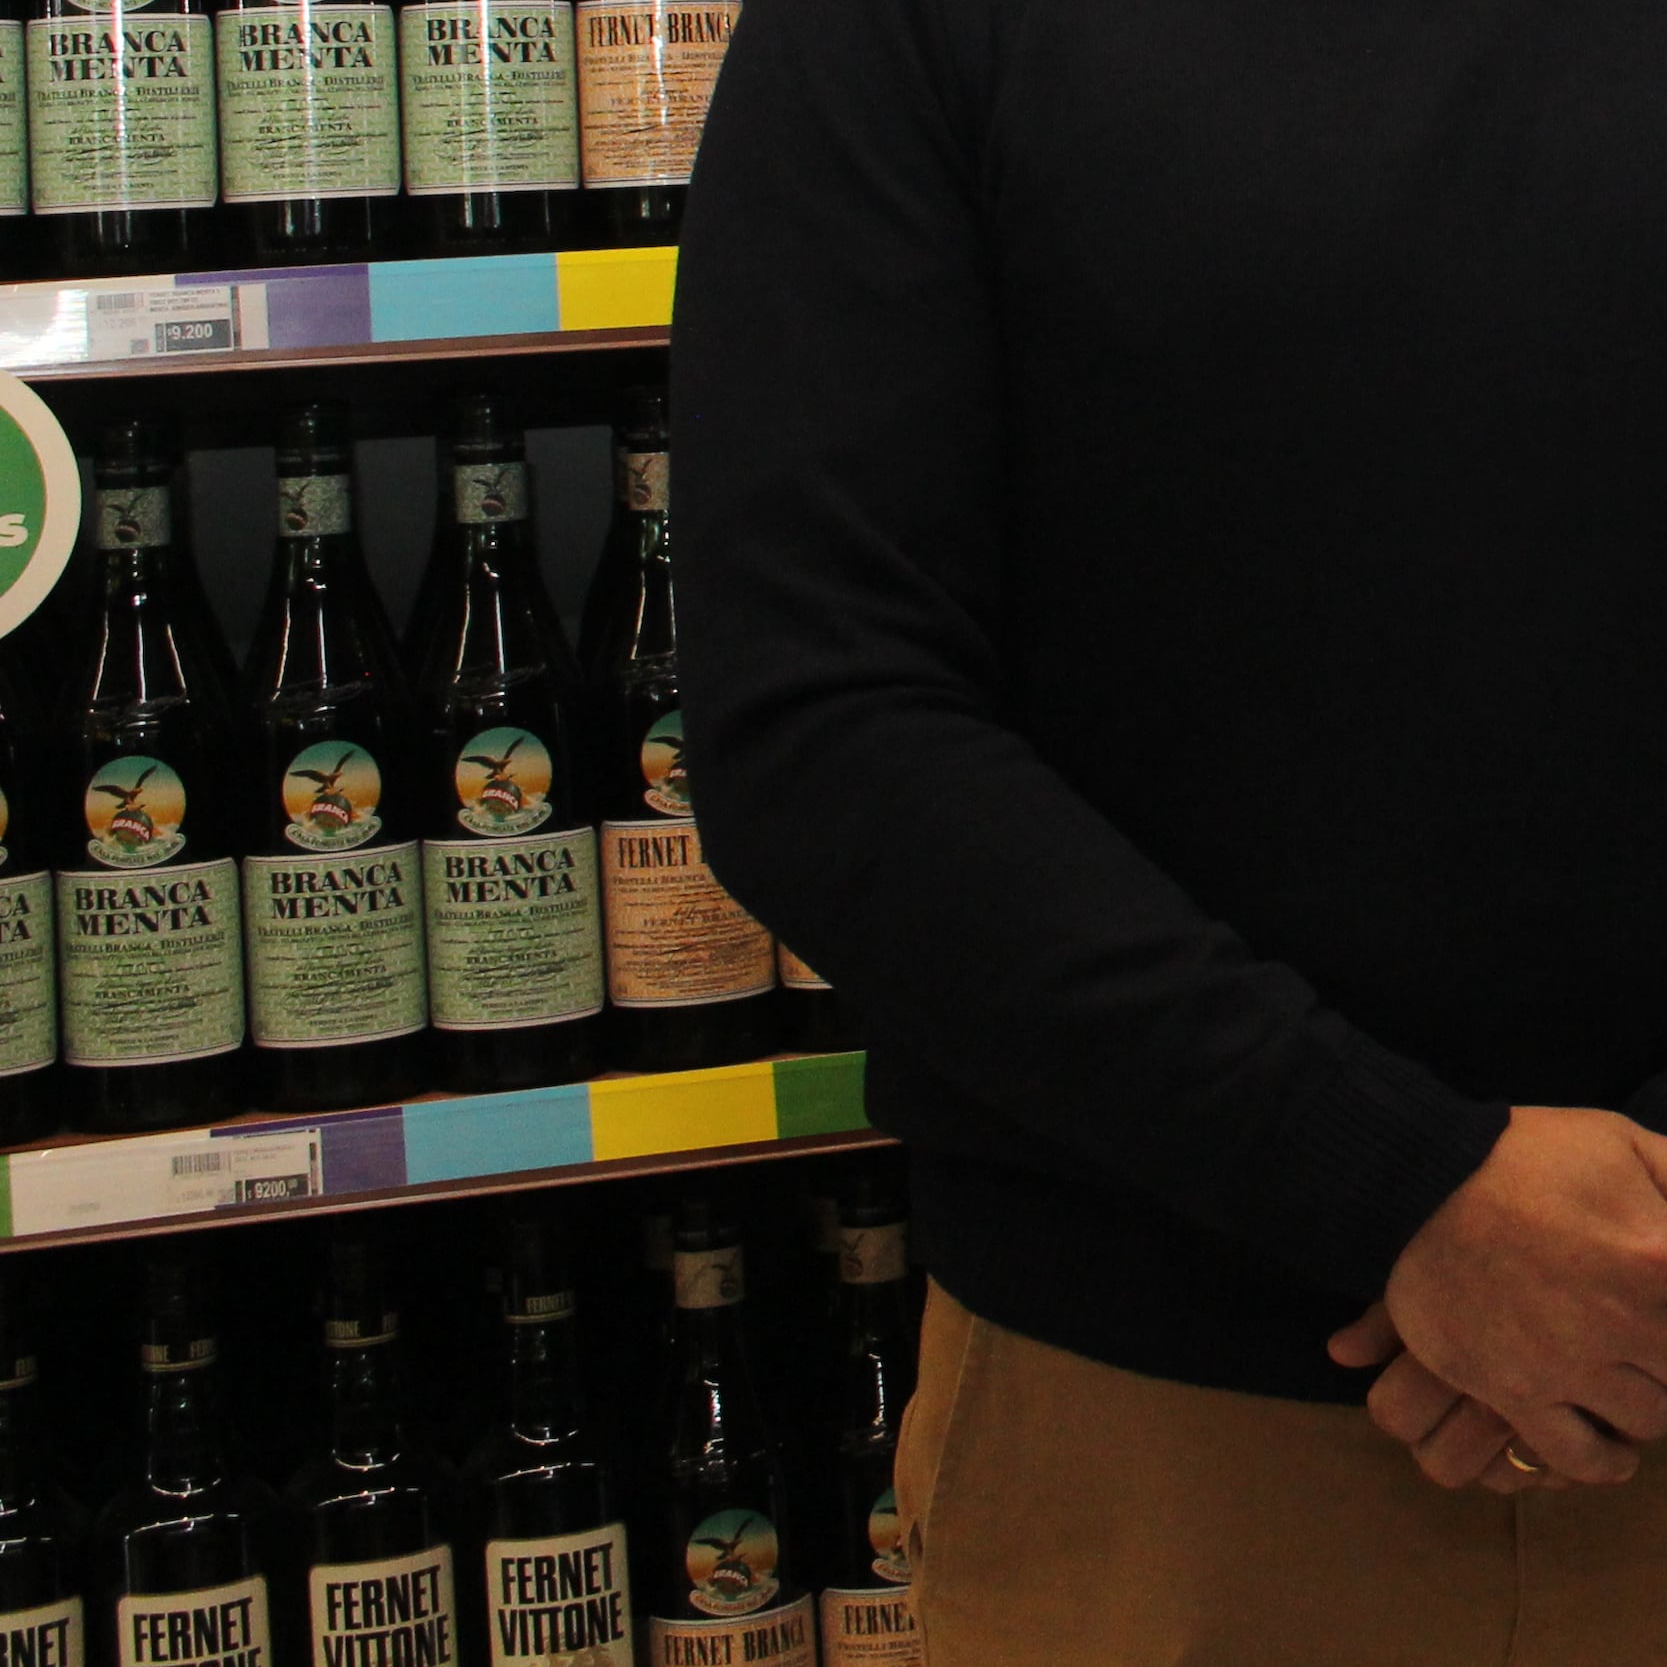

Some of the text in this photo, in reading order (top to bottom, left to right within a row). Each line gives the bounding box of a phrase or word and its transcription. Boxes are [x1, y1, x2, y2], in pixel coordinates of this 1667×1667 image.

[50, 30, 187, 56] BRANCA
[240, 21, 373, 48] BRANCA
[427, 15, 556, 43] BRANCA
[50, 55, 188, 83] MENTA
[240, 46, 373, 73] MENTA
[427, 40, 556, 67] MENTA
[445, 846, 577, 880] BRANCA
[617, 834, 691, 869] FERNET
[270, 861, 405, 895] BRANCA
[445, 871, 578, 904] MENTA
[75, 879, 212, 912] BRANCA
[270, 886, 405, 920] MENTA
[76, 904, 212, 937] MENTA
[501, 1541, 613, 1605] FERNET
[326, 1564, 441, 1631] FERNET
[133, 1596, 254, 1663] FERNET
[323, 1614, 451, 1667] VITTONE
[498, 1590, 625, 1658] VITTONE
[664, 1633, 734, 1666] FERNET
